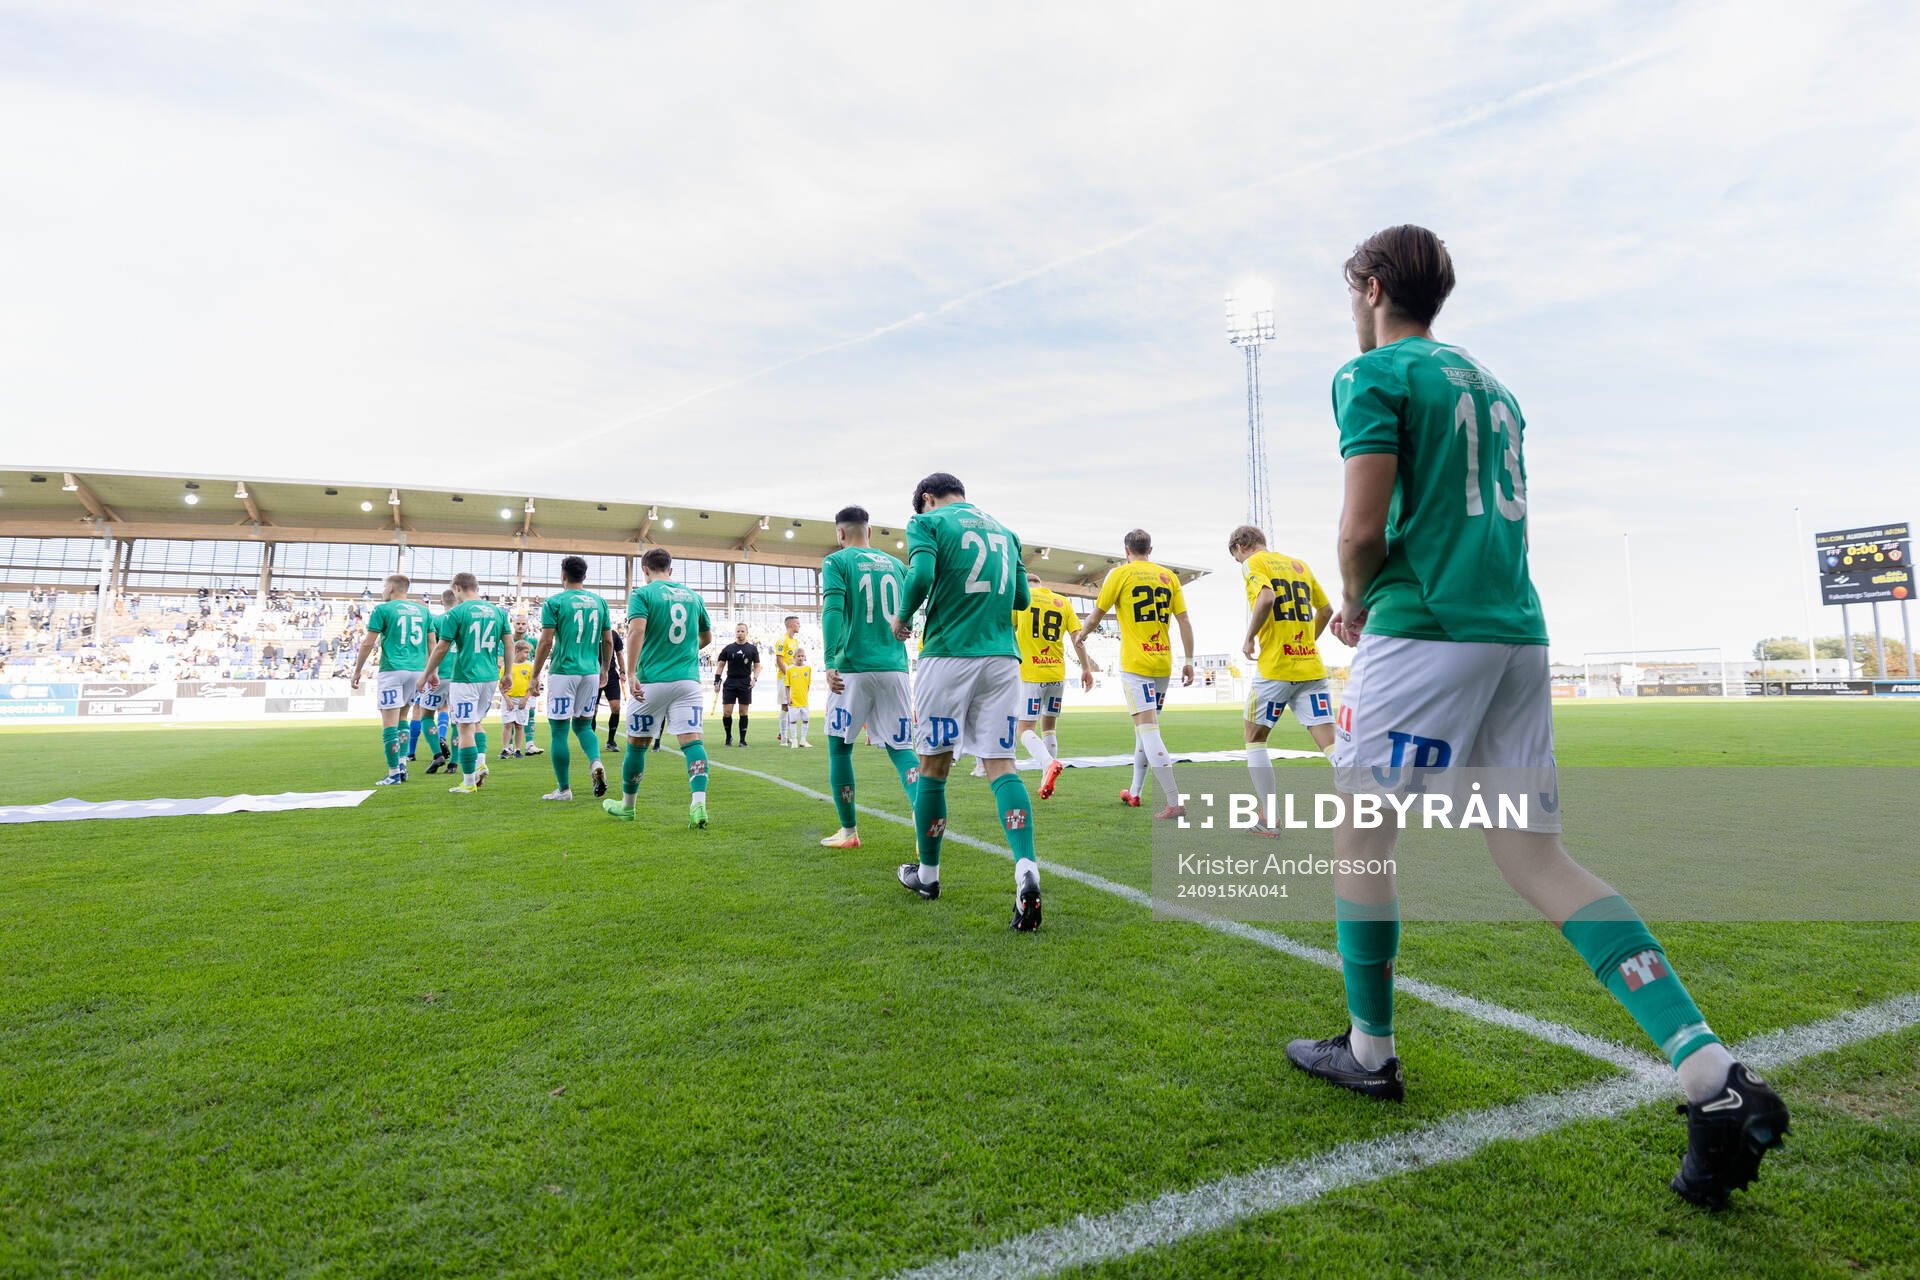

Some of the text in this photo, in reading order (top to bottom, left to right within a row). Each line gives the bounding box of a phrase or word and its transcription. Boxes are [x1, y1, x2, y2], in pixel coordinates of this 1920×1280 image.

[1455, 391, 1526, 522] 13
[961, 530, 1008, 595] 27
[859, 573, 900, 625] 10
[1132, 585, 1172, 624] 22
[1270, 578, 1313, 622] 28
[397, 615, 424, 645] 15
[469, 620, 496, 653] 14
[573, 609, 598, 644] 11
[668, 603, 687, 644] 8
[1030, 606, 1063, 642] 18
[381, 690, 397, 705] JP
[425, 694, 441, 707] JP
[456, 702, 473, 718] JP
[552, 698, 570, 715] JP
[630, 713, 654, 732] JP
[926, 716, 959, 748] JP
[1371, 730, 1452, 793] JP
